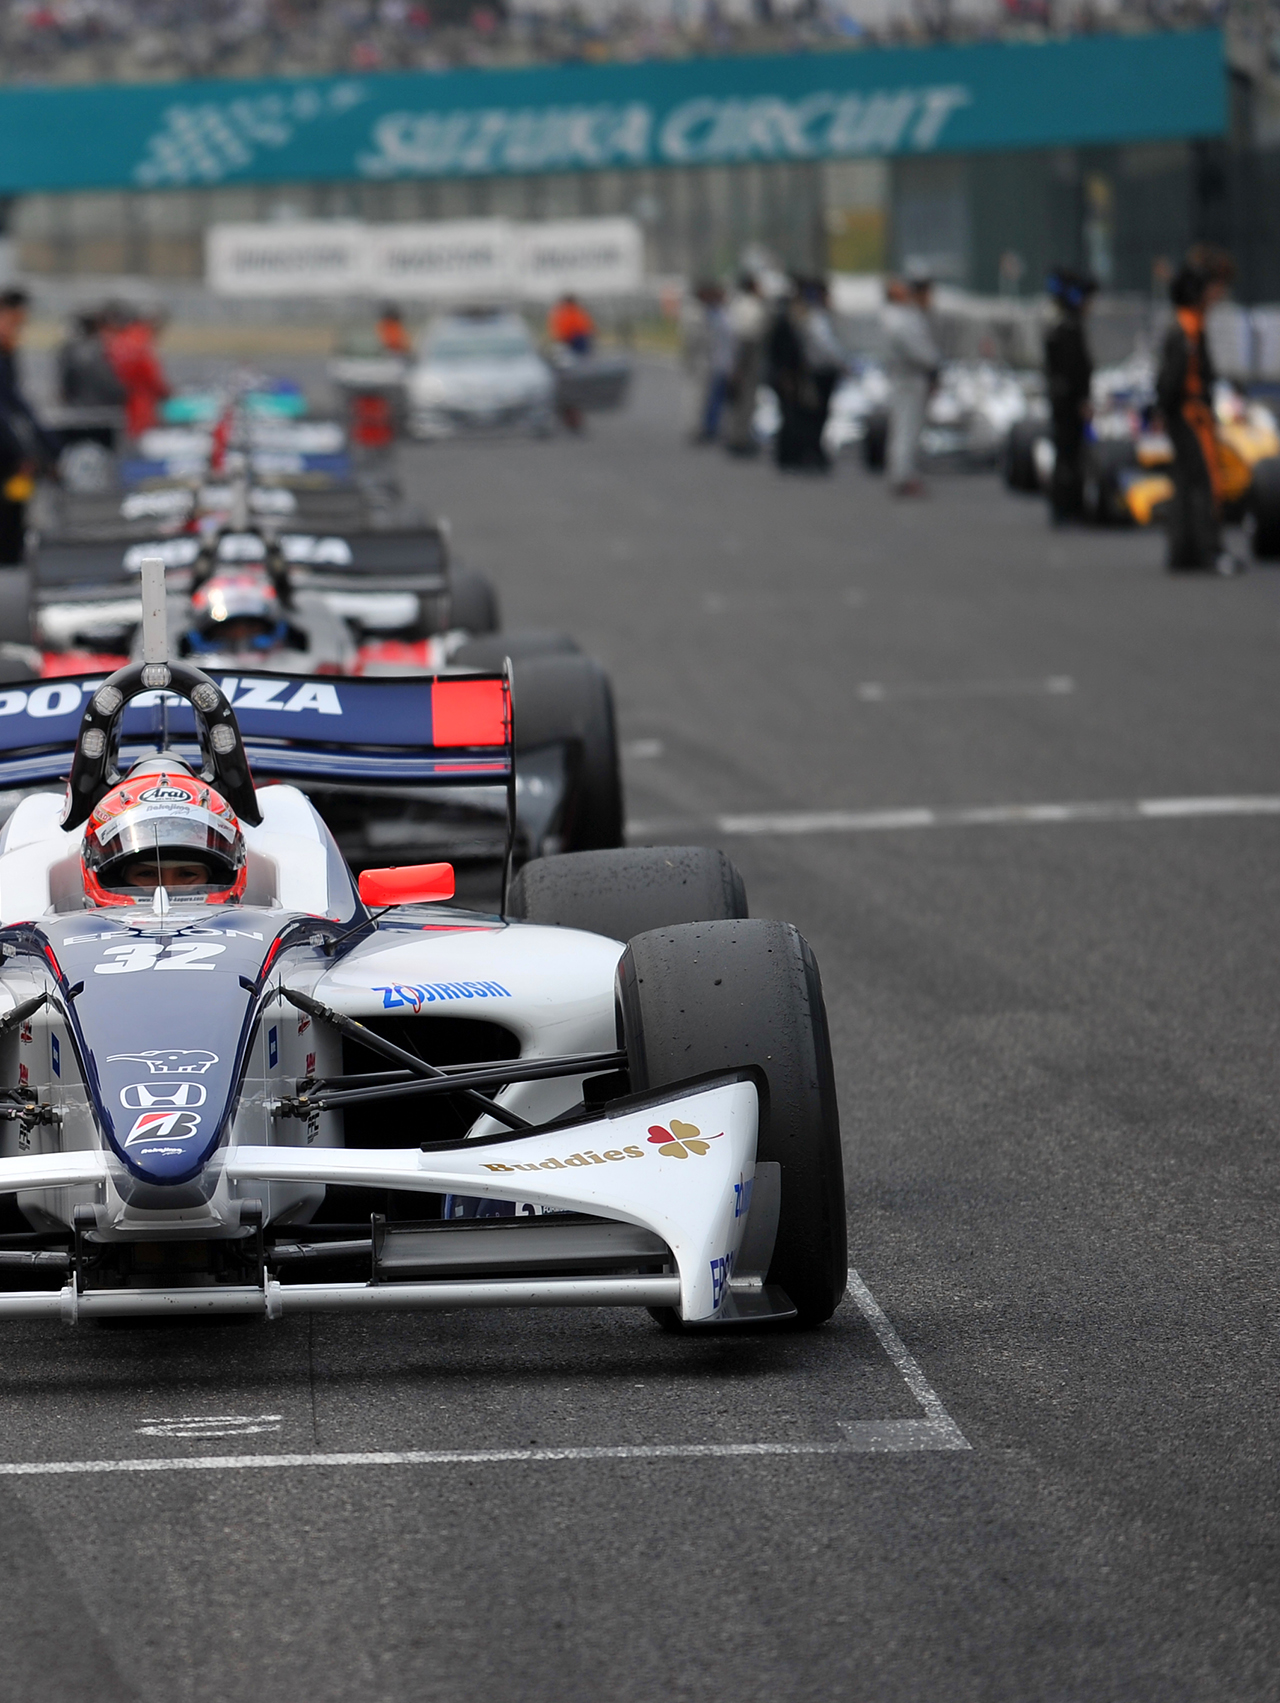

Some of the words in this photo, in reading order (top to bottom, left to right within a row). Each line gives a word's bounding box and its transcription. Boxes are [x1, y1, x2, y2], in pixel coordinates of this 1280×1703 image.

[355, 103, 651, 177] SUZUKA
[659, 84, 967, 160] CIRCUIT
[149, 787, 184, 798] Arai
[63, 928, 264, 947] EPSON
[93, 942, 227, 974] 32
[371, 980, 513, 1011] ZOJIRUSHI
[479, 1145, 645, 1172] Buddies
